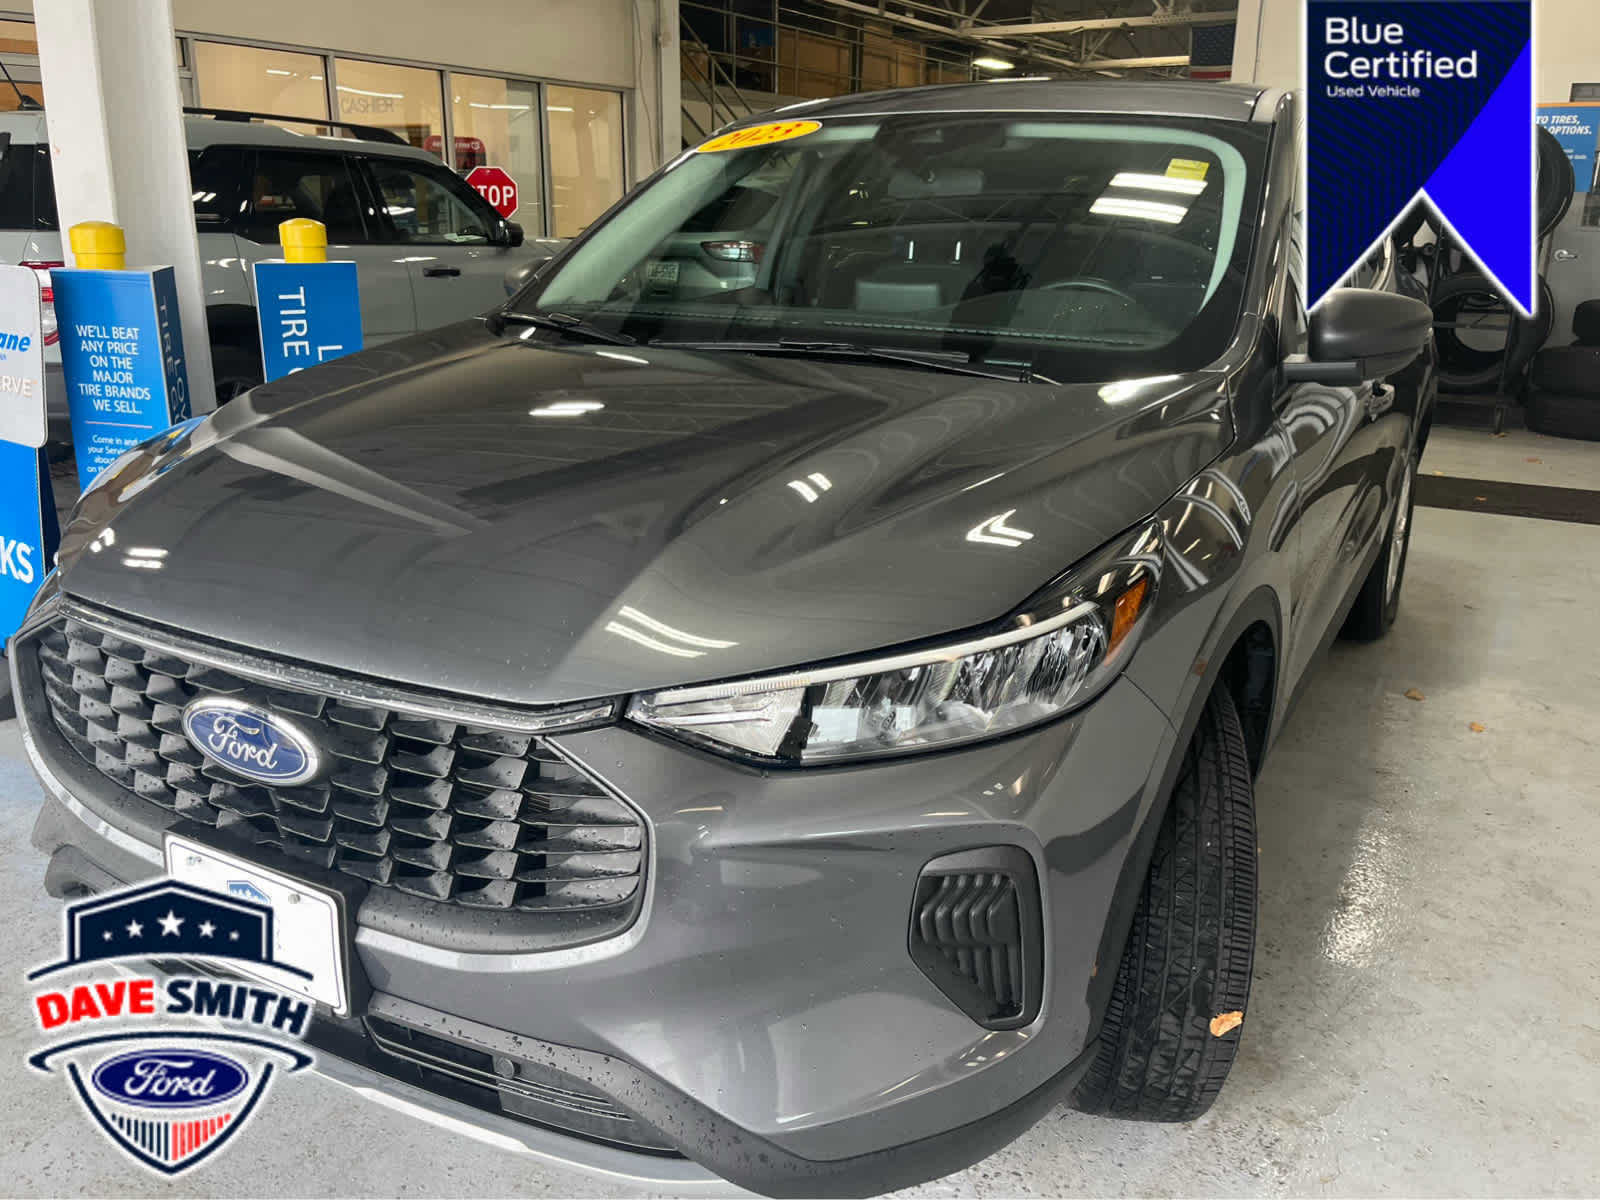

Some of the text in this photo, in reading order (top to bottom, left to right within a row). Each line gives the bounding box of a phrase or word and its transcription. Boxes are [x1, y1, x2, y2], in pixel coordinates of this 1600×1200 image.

[340, 97, 395, 114] CASHIER
[1551, 115, 1580, 126] TIRES,
[472, 185, 515, 207] TOP
[278, 286, 310, 358] TIRE
[75, 324, 140, 340] WE'LL BEAT
[81, 340, 139, 355] ANY PRICE
[89, 355, 134, 370] ON THE
[92, 369, 133, 384] MAJOR
[78, 383, 151, 401] TIRE BRANDS
[93, 399, 143, 414] WE SELL.
[207, 716, 279, 769] Ford
